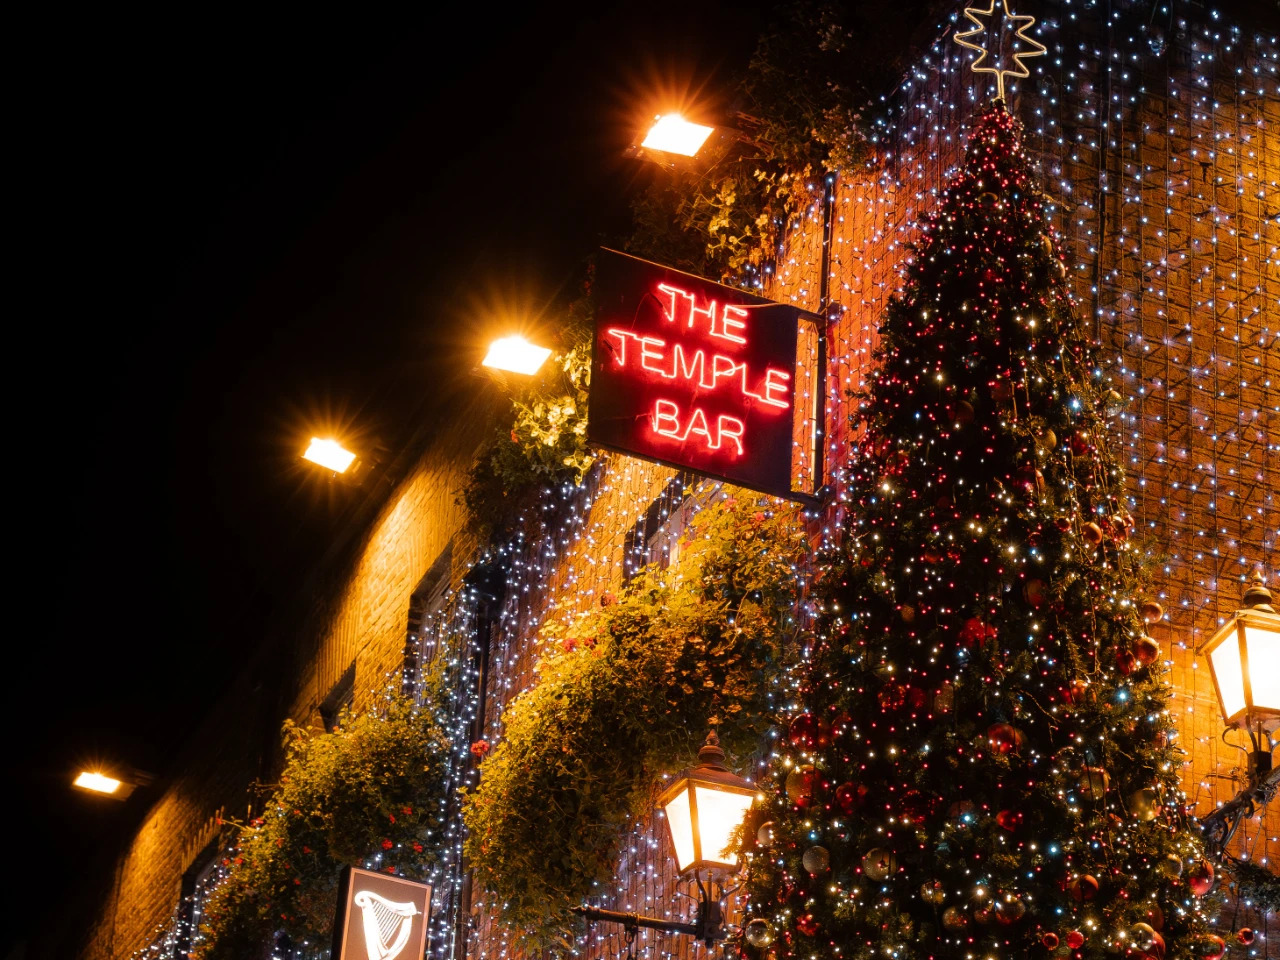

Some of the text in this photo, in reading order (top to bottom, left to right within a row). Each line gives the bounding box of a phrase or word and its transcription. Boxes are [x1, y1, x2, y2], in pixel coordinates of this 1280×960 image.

[658, 283, 748, 344] THE
[608, 329, 790, 408] TEMPLE
[652, 400, 744, 455] BAR
